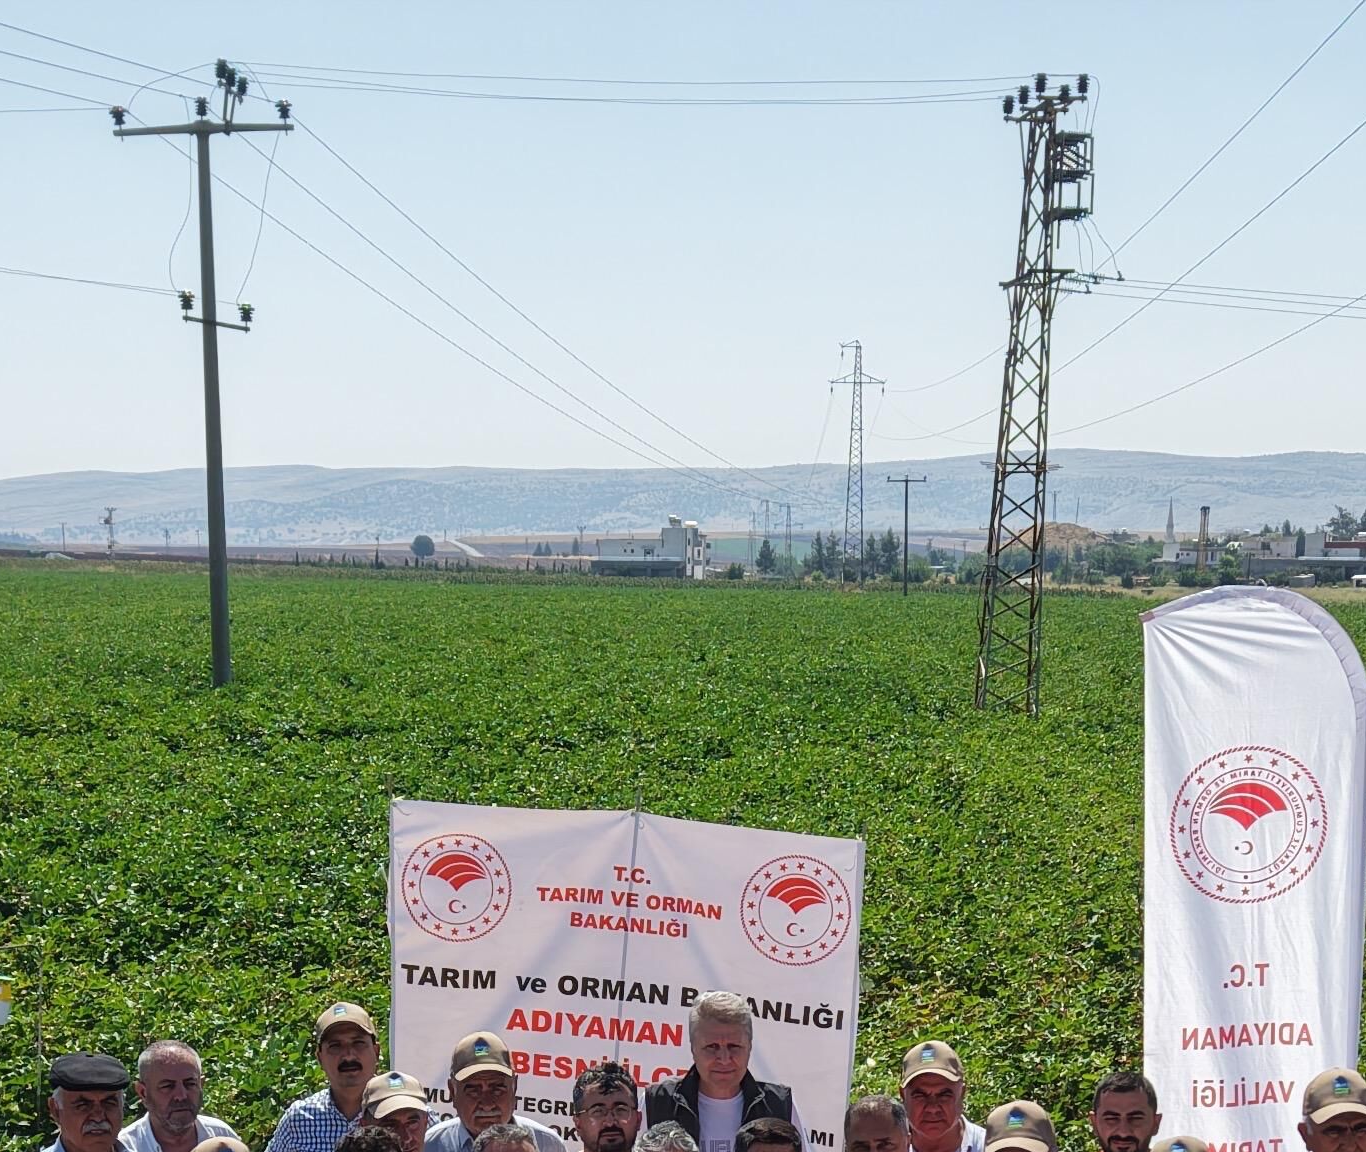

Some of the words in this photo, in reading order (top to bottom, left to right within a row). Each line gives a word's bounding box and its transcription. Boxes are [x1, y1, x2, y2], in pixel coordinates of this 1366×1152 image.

[613, 866, 651, 885] T.C.
[536, 886, 603, 905] TARIM
[610, 890, 639, 908] VE
[645, 894, 722, 921] ORMAN
[570, 911, 688, 938] BAKANLIĞI
[401, 963, 496, 989] TARIM
[516, 975, 547, 993] ve
[558, 975, 669, 1005] ORMAN
[681, 987, 844, 1030] BANLIĞI
[506, 1009, 683, 1047] ADIYAMAN
